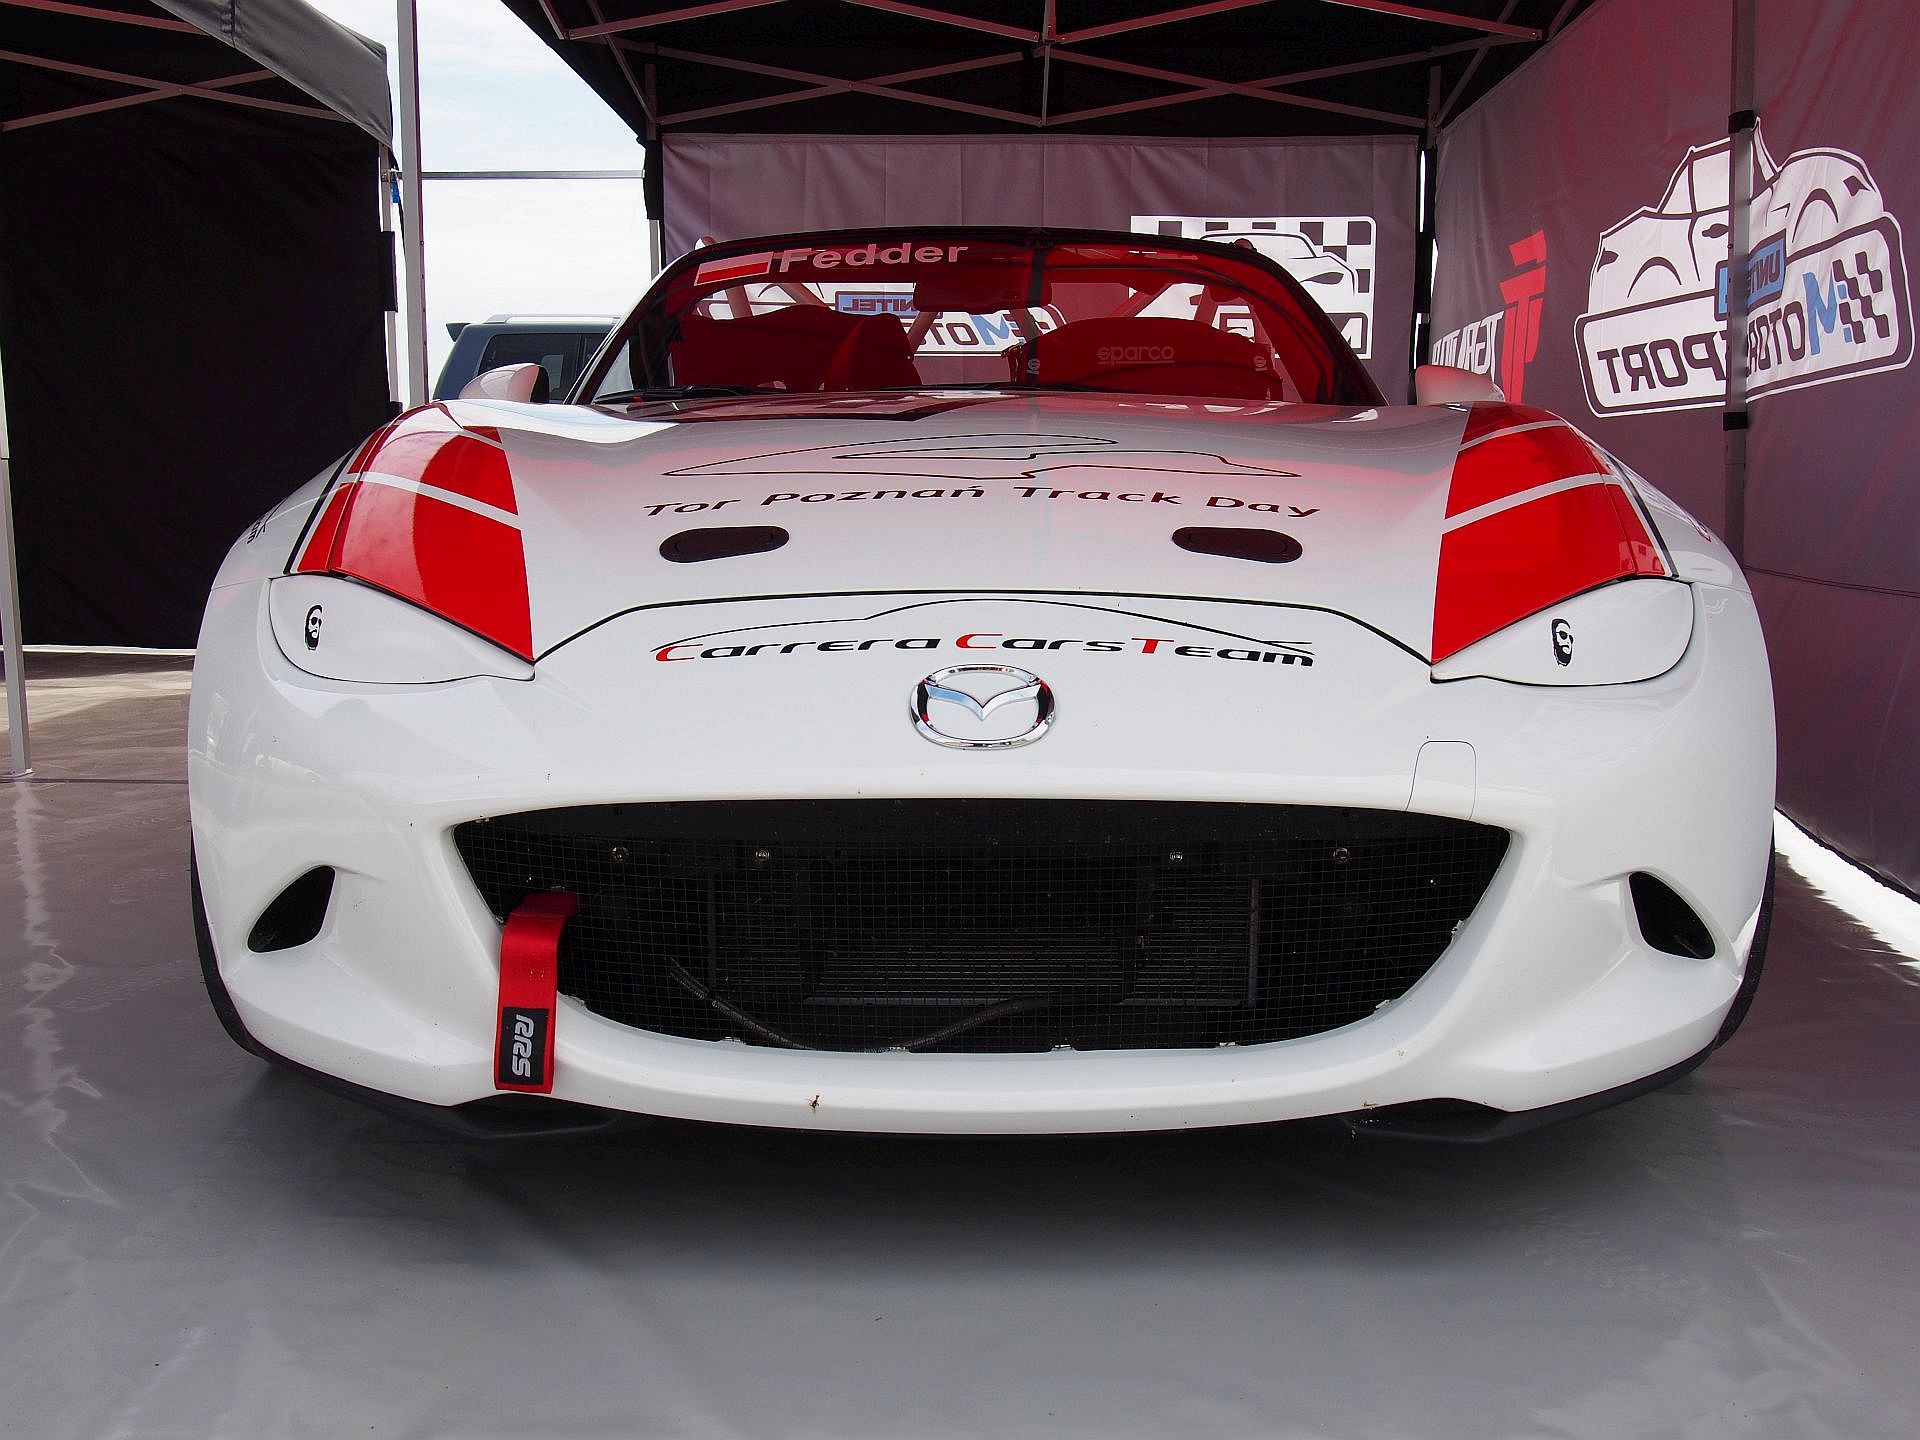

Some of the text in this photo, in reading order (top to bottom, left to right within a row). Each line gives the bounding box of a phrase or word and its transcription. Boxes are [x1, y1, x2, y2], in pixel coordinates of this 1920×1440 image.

[779, 243, 968, 272] Fedder
[1097, 345, 1175, 366] sparco
[643, 485, 1321, 518] Tor Poznań Track Day
[512, 1013, 535, 1078] RRS
